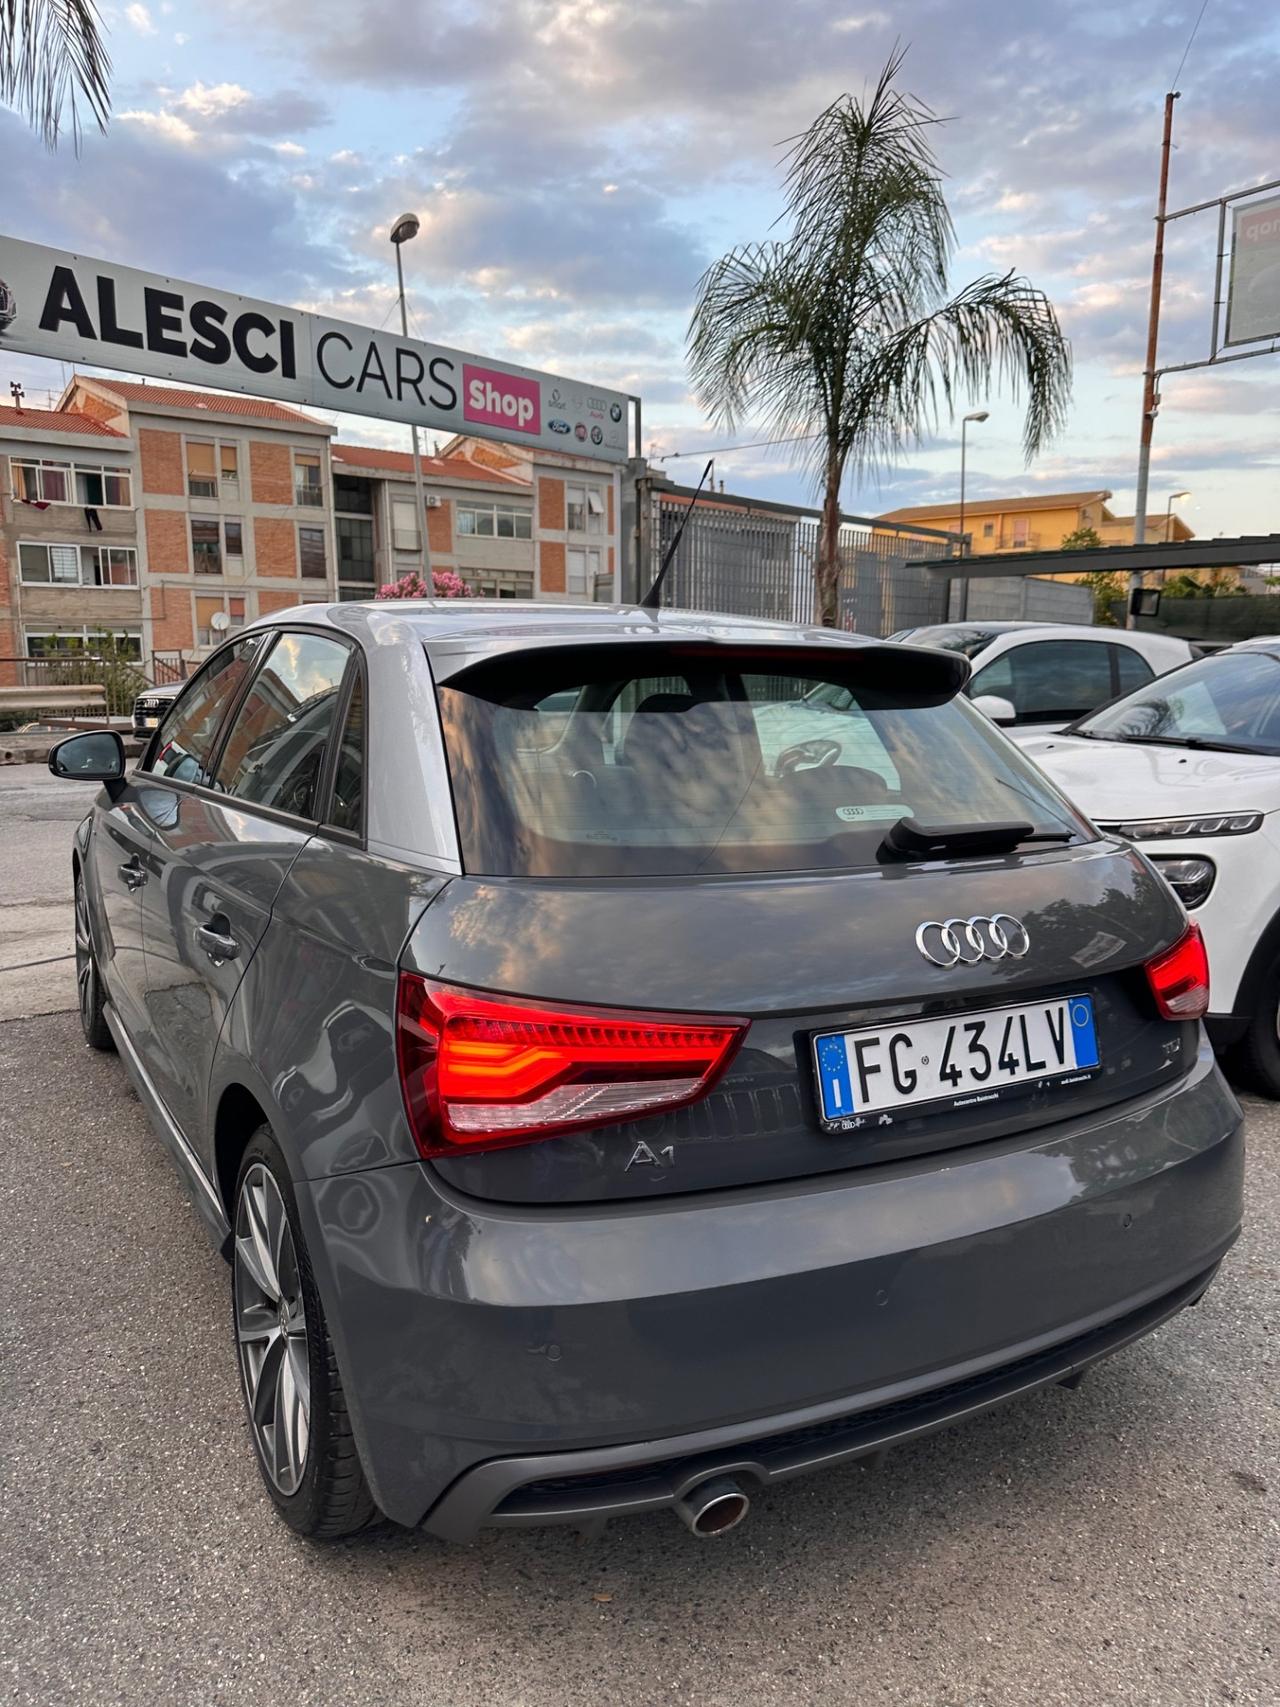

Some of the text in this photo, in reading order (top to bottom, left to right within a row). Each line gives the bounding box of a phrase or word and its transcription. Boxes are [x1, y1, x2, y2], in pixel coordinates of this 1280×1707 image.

[39, 265, 457, 411] ALESCI CARS
[469, 379, 534, 427] Shop
[854, 1006, 1065, 1103] FG 434LV
[624, 1140, 675, 1172] A1
